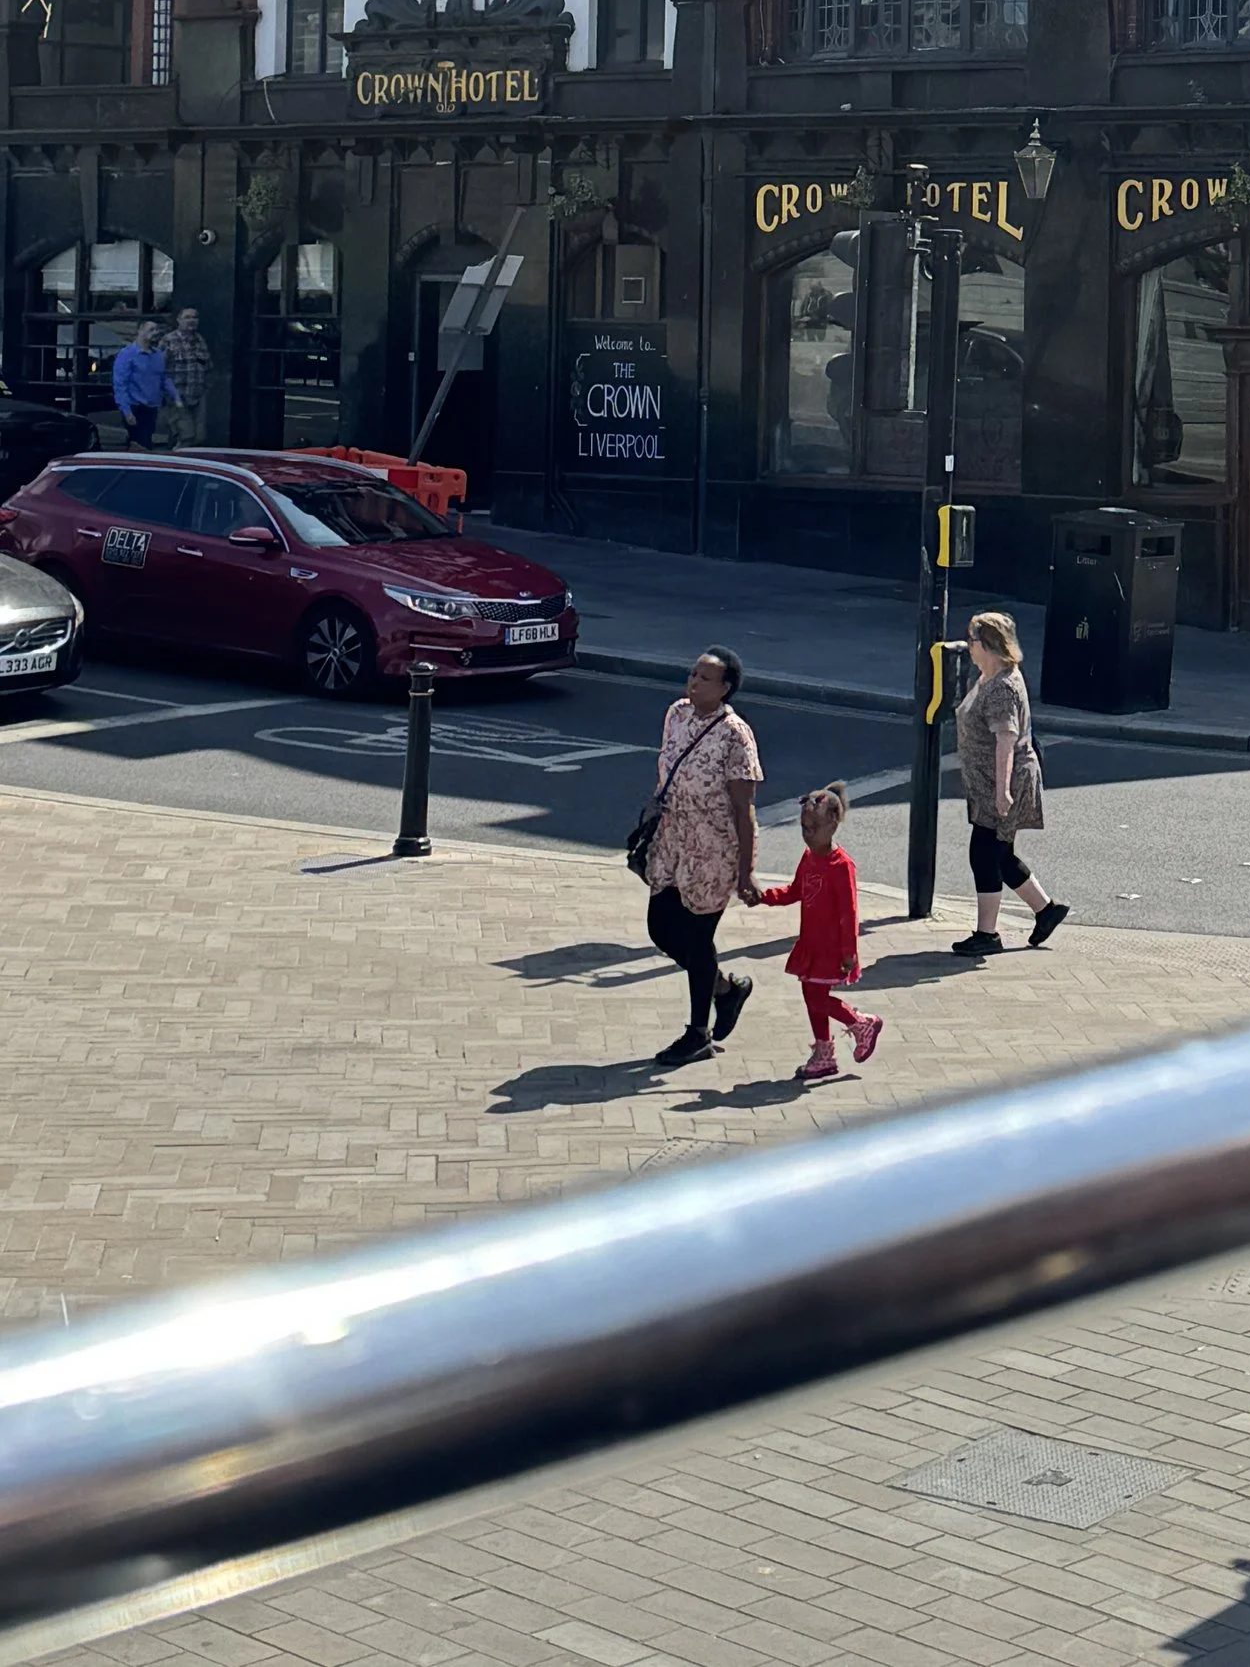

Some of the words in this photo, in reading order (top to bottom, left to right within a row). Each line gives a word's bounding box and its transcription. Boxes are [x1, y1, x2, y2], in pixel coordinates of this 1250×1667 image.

[356, 71, 443, 105] CROWN
[450, 69, 540, 103] HOTEL
[756, 181, 850, 233] CROW
[1117, 178, 1229, 231] CROW
[594, 335, 634, 350] Welcome
[613, 362, 636, 379] THE
[587, 383, 660, 419] CROWN
[578, 432, 665, 458] LIVERPOOL
[107, 529, 146, 551] DELTA
